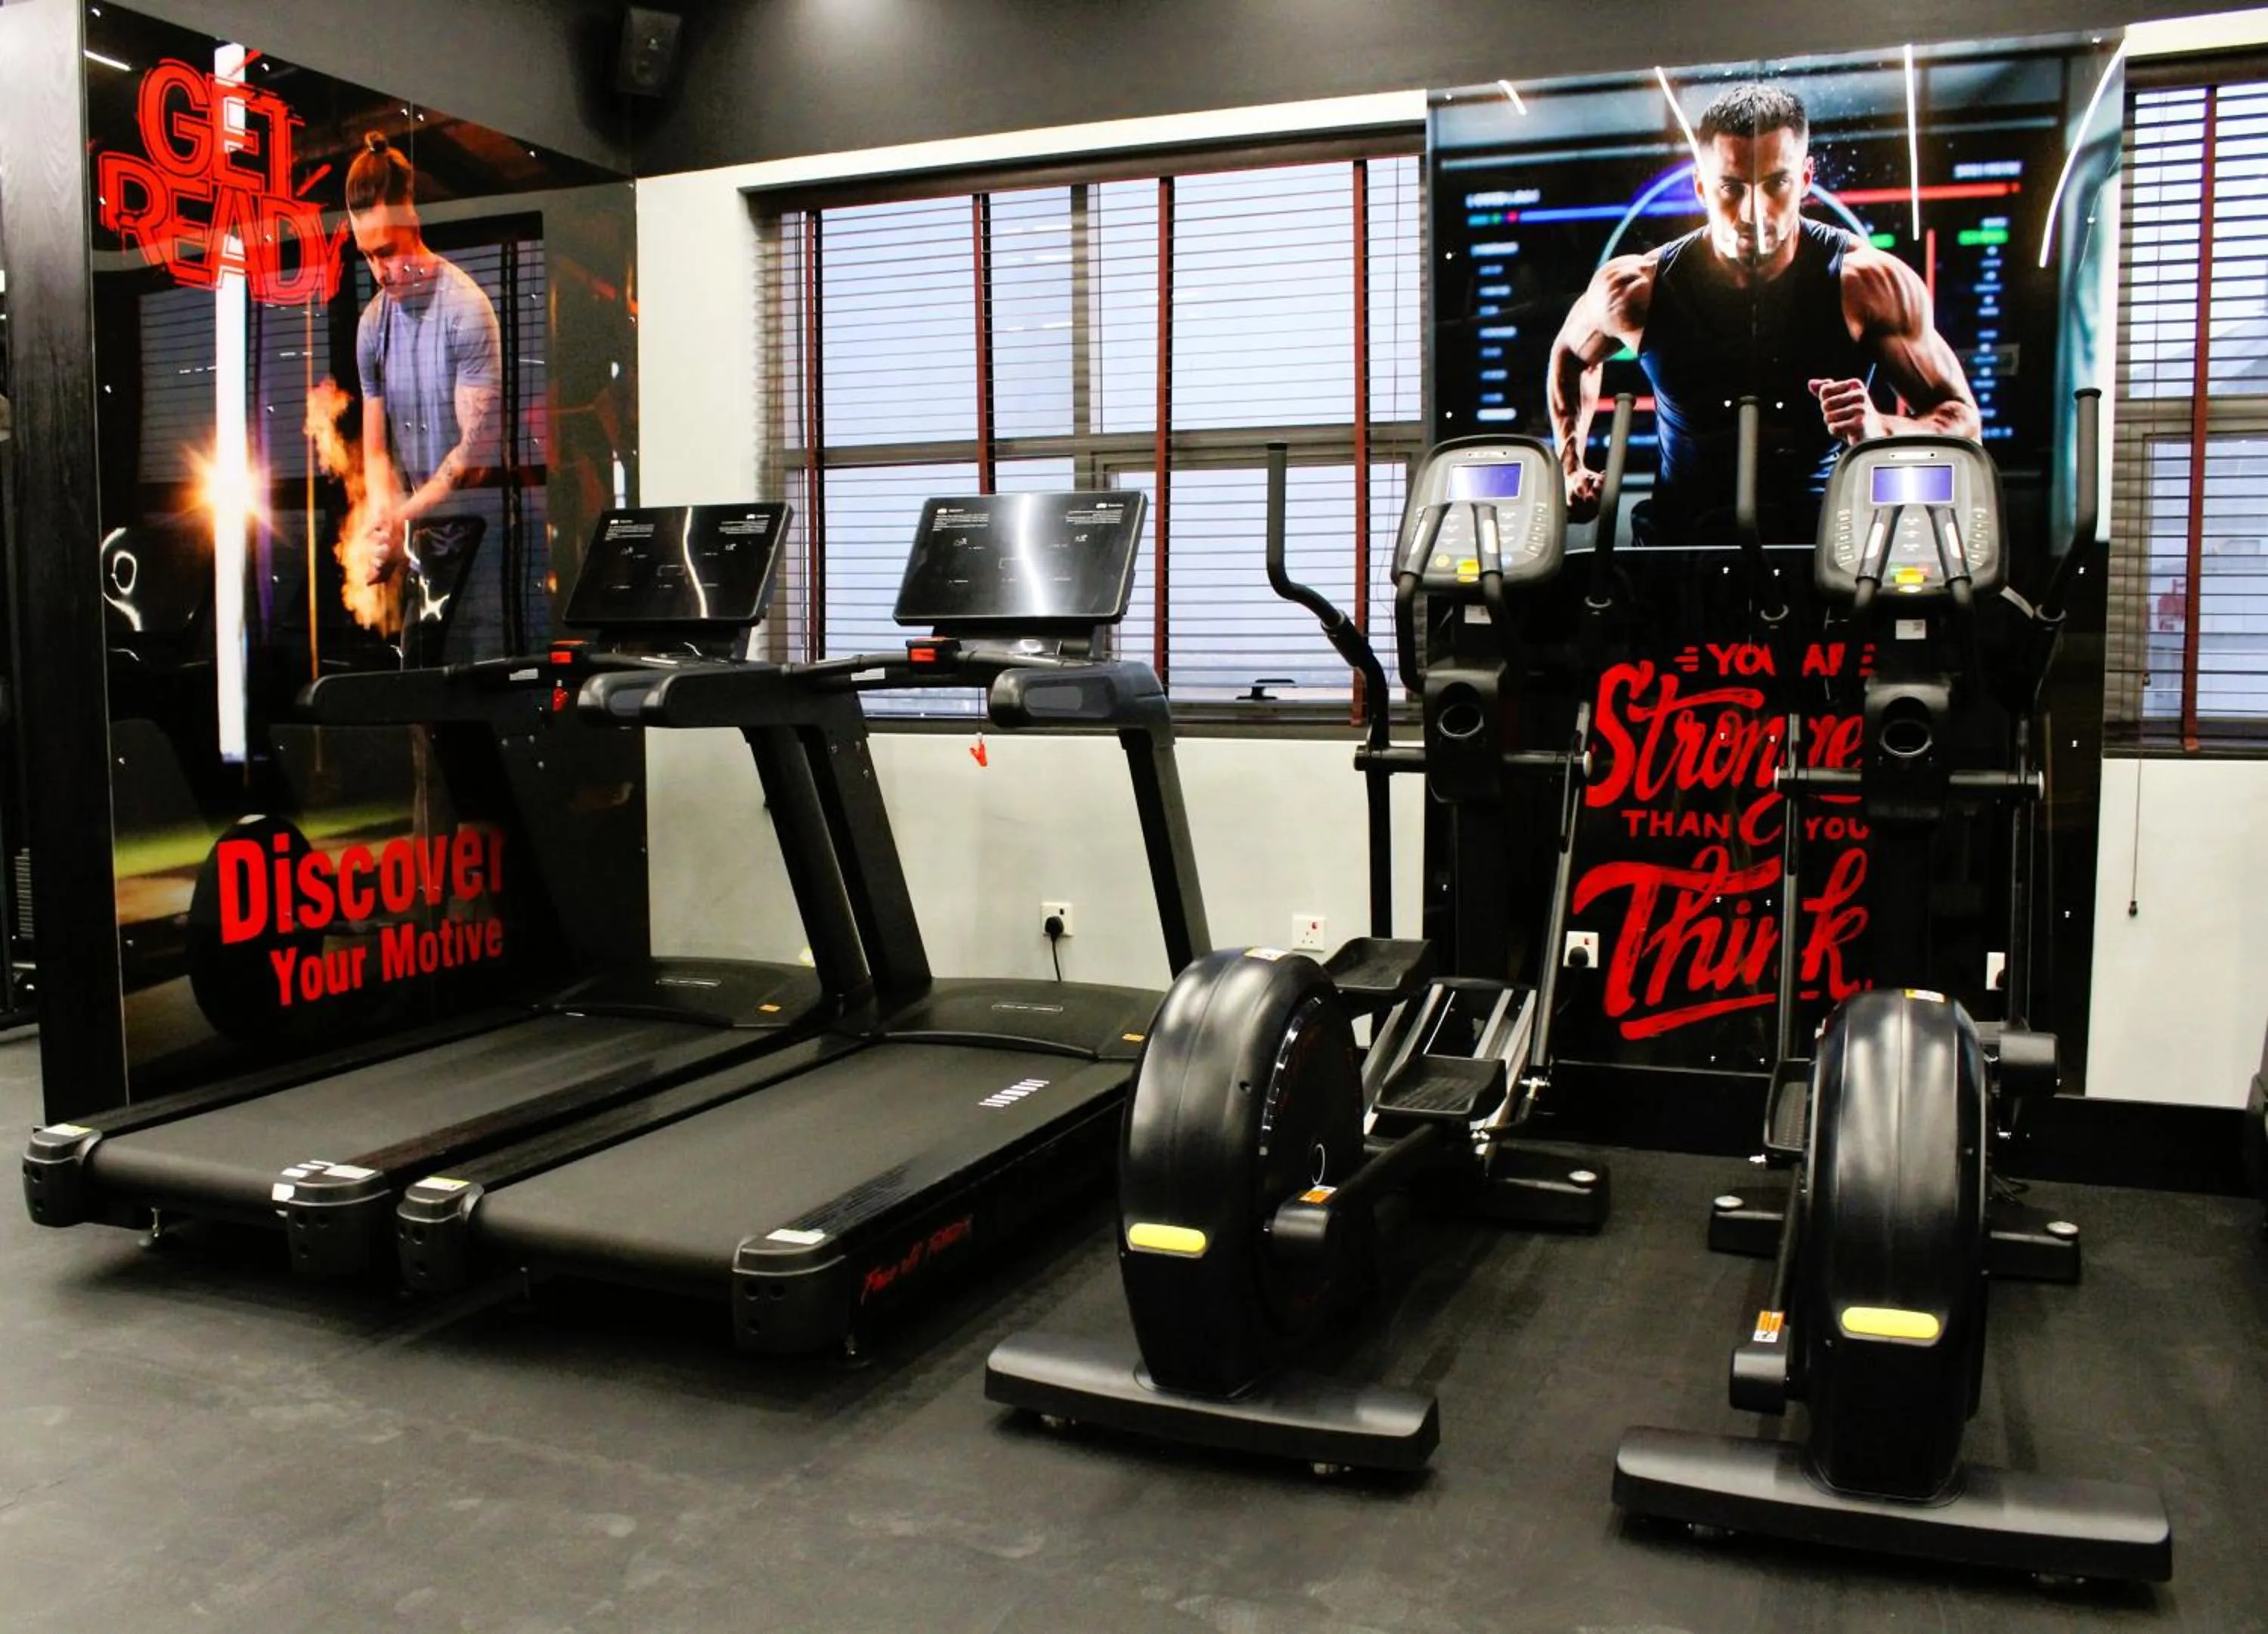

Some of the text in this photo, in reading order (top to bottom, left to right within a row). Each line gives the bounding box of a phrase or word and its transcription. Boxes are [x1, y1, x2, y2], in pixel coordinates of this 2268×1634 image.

[138, 59, 305, 200] GET
[98, 151, 348, 305] READY
[1585, 660, 1864, 846] Strone
[217, 827, 504, 944] Discover
[1622, 810, 1870, 839] THAN YOU
[270, 916, 503, 1006] Your Motive
